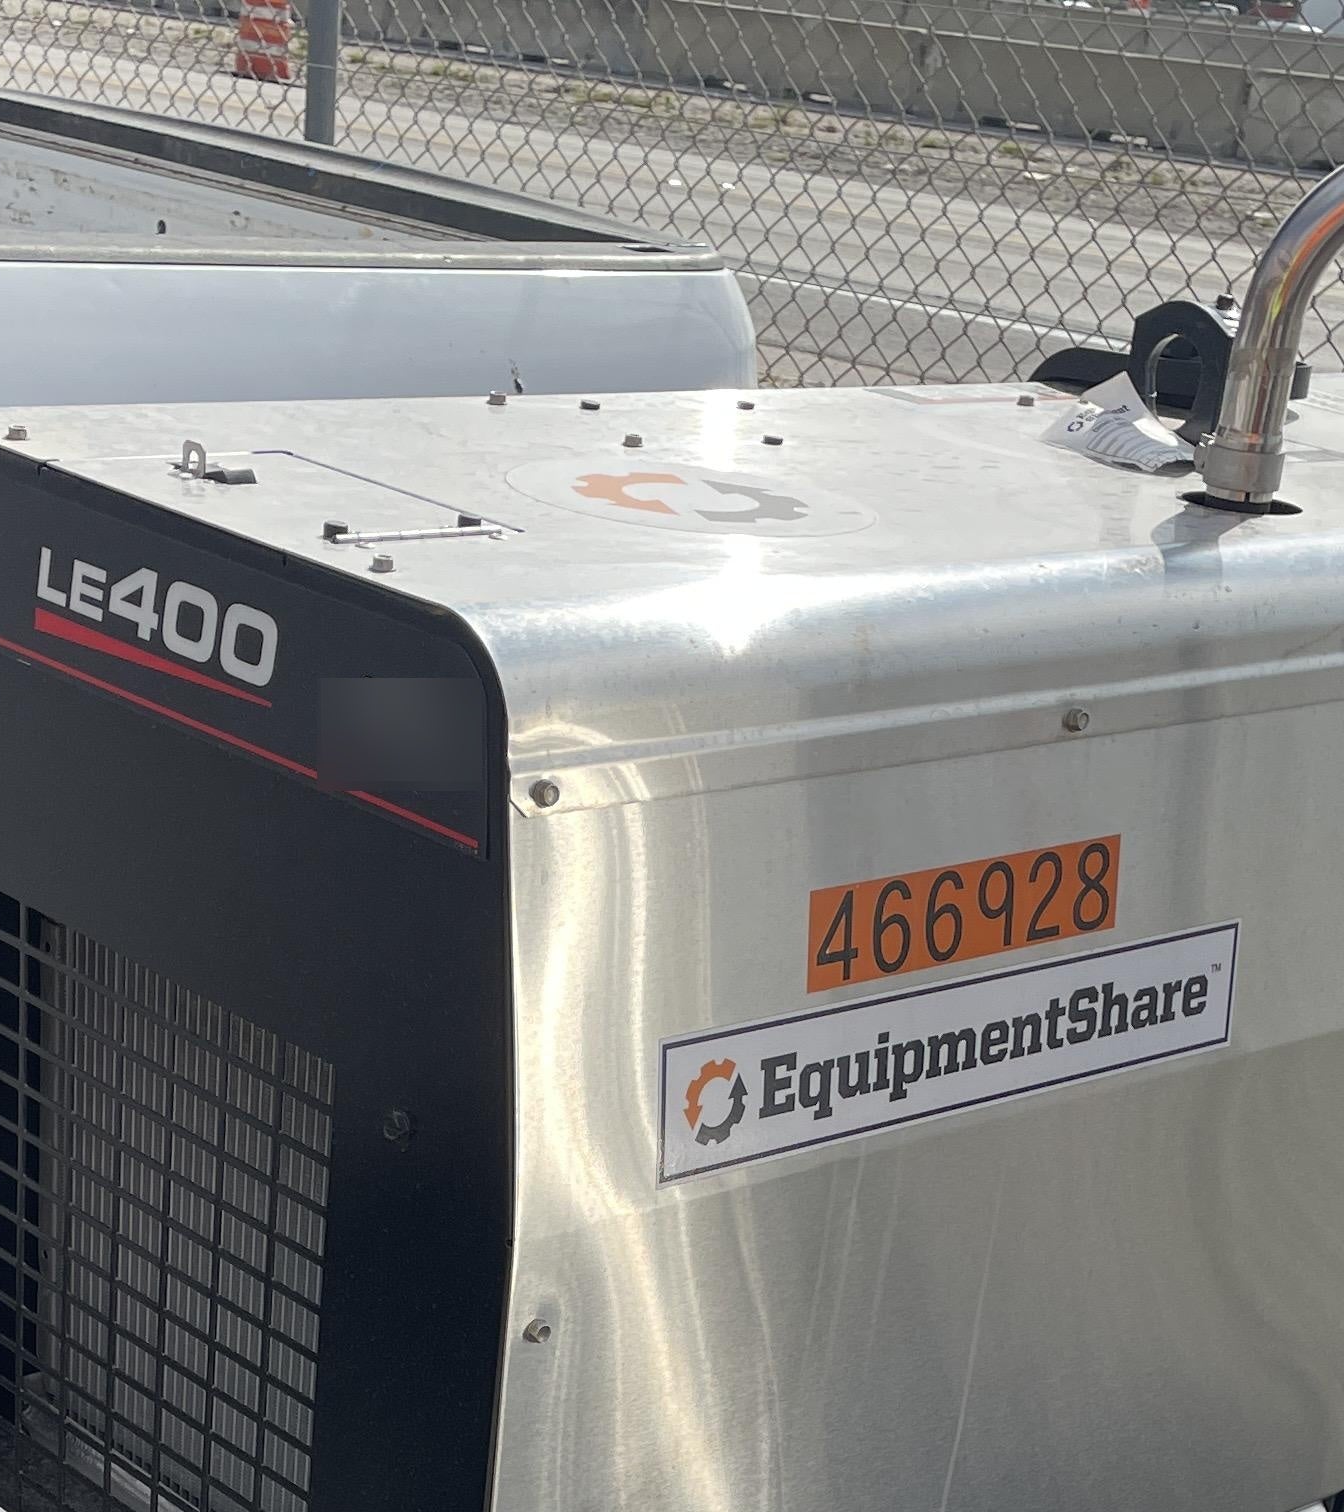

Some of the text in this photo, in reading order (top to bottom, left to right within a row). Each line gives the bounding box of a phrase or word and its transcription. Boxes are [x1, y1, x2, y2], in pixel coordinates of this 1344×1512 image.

[36, 545, 279, 687] LE400
[815, 842, 1112, 981] 466928
[758, 972, 1209, 1121] EquipmentShare
